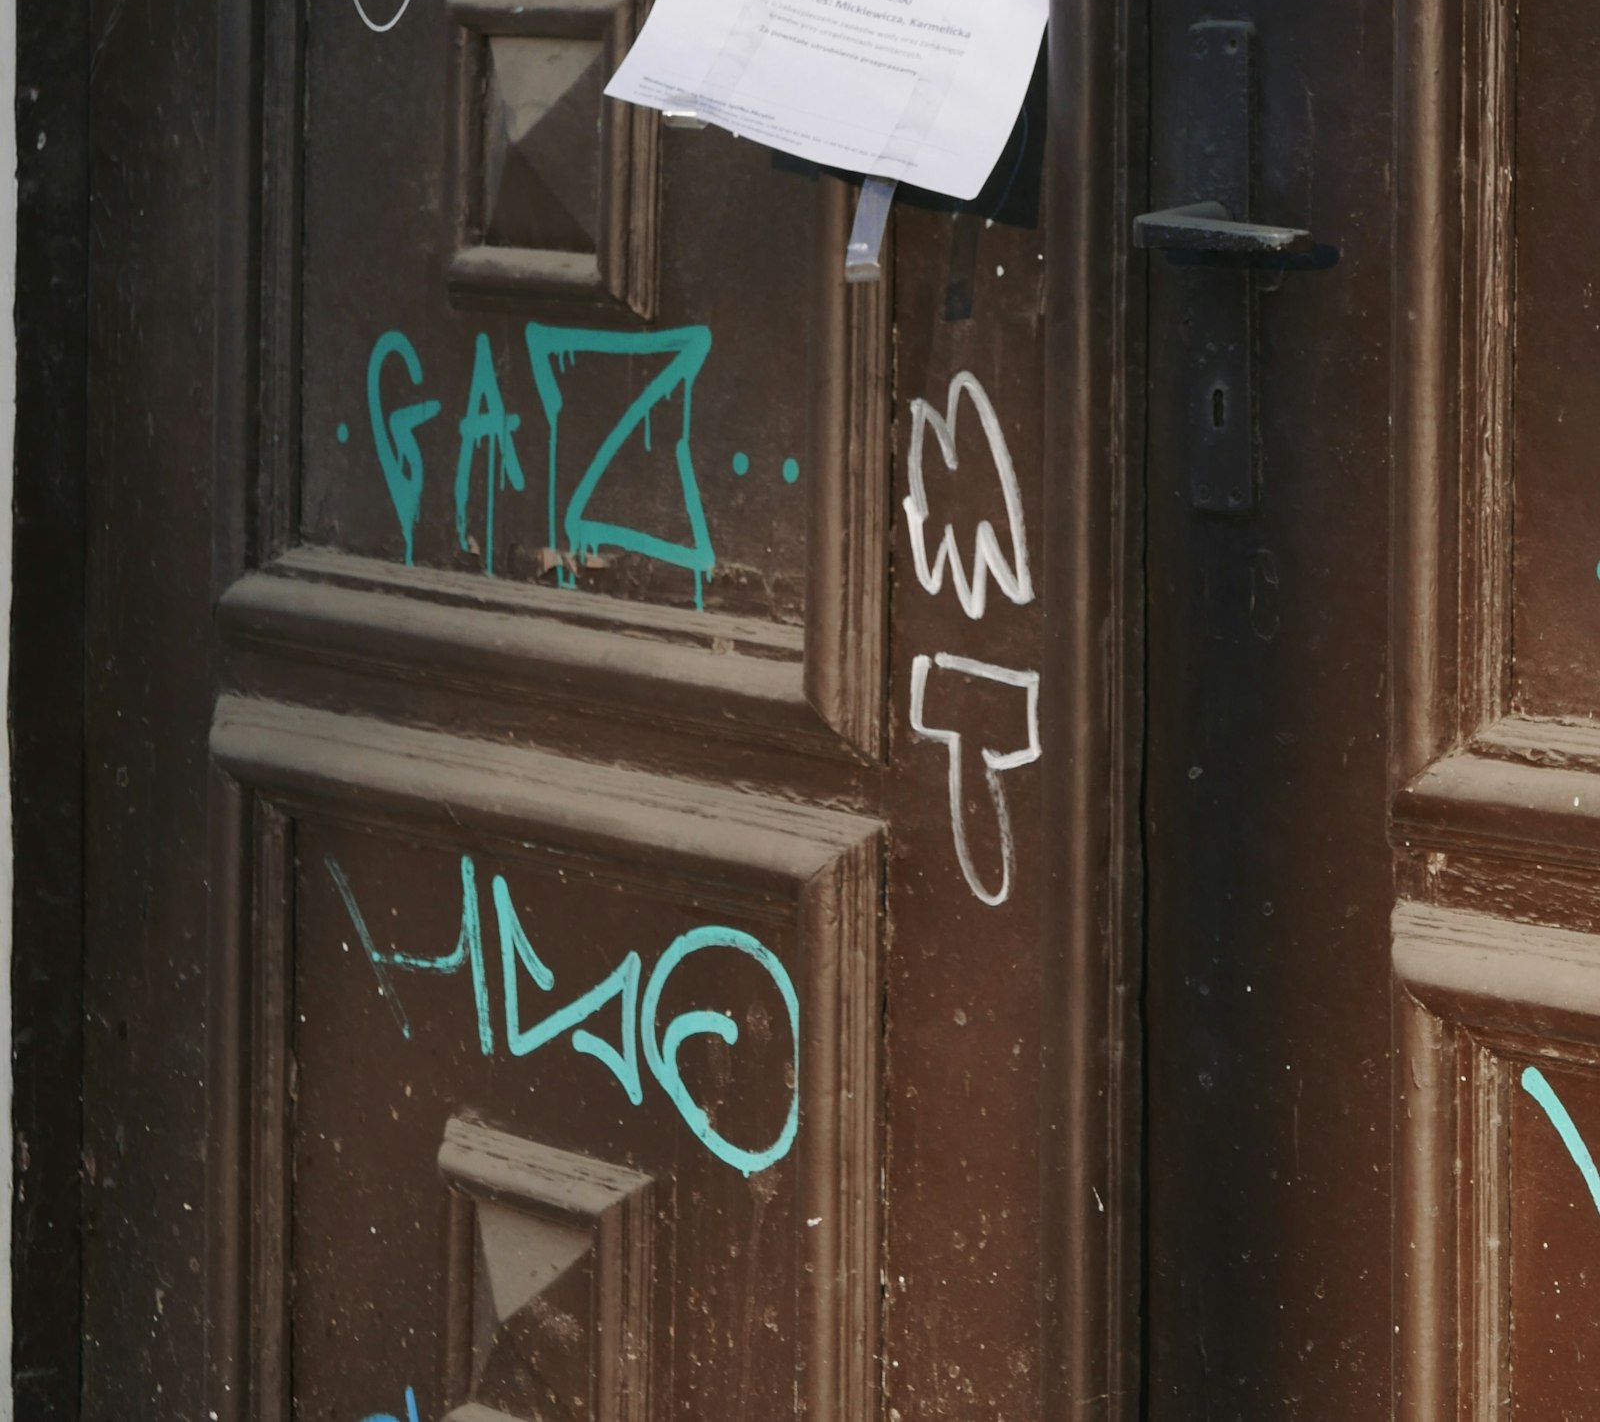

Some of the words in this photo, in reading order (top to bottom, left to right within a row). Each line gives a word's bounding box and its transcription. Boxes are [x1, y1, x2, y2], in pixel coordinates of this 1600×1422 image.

[835, 0, 906, 26] Mickiewicza,
[909, 18, 972, 40] Karmelicka
[367, 321, 716, 593] GAZ
